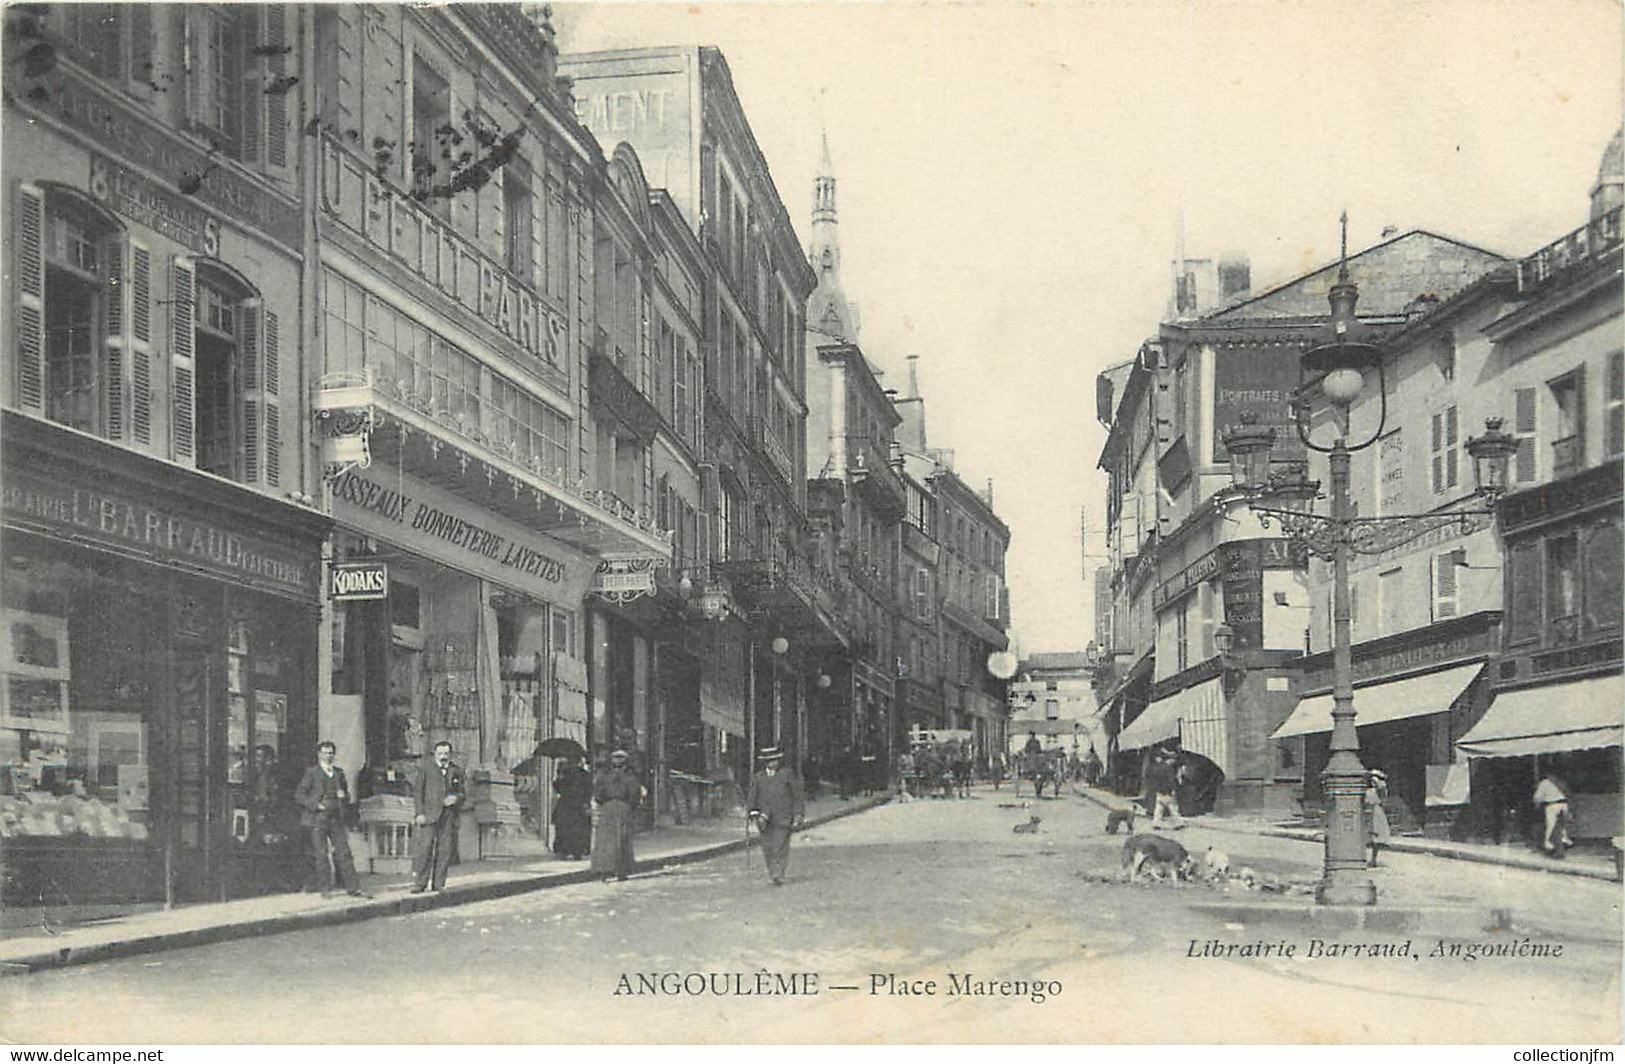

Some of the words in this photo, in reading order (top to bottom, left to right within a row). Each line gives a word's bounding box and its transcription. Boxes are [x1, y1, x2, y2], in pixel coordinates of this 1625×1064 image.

[363, 172, 466, 303] PETIT
[479, 257, 561, 364] PARIS
[99, 498, 242, 568] BARRAUD
[330, 469, 412, 524] USSEAUX
[412, 504, 505, 560] BONNETERIE
[502, 540, 566, 585] LAYETTES
[331, 569, 385, 595] KODAKS
